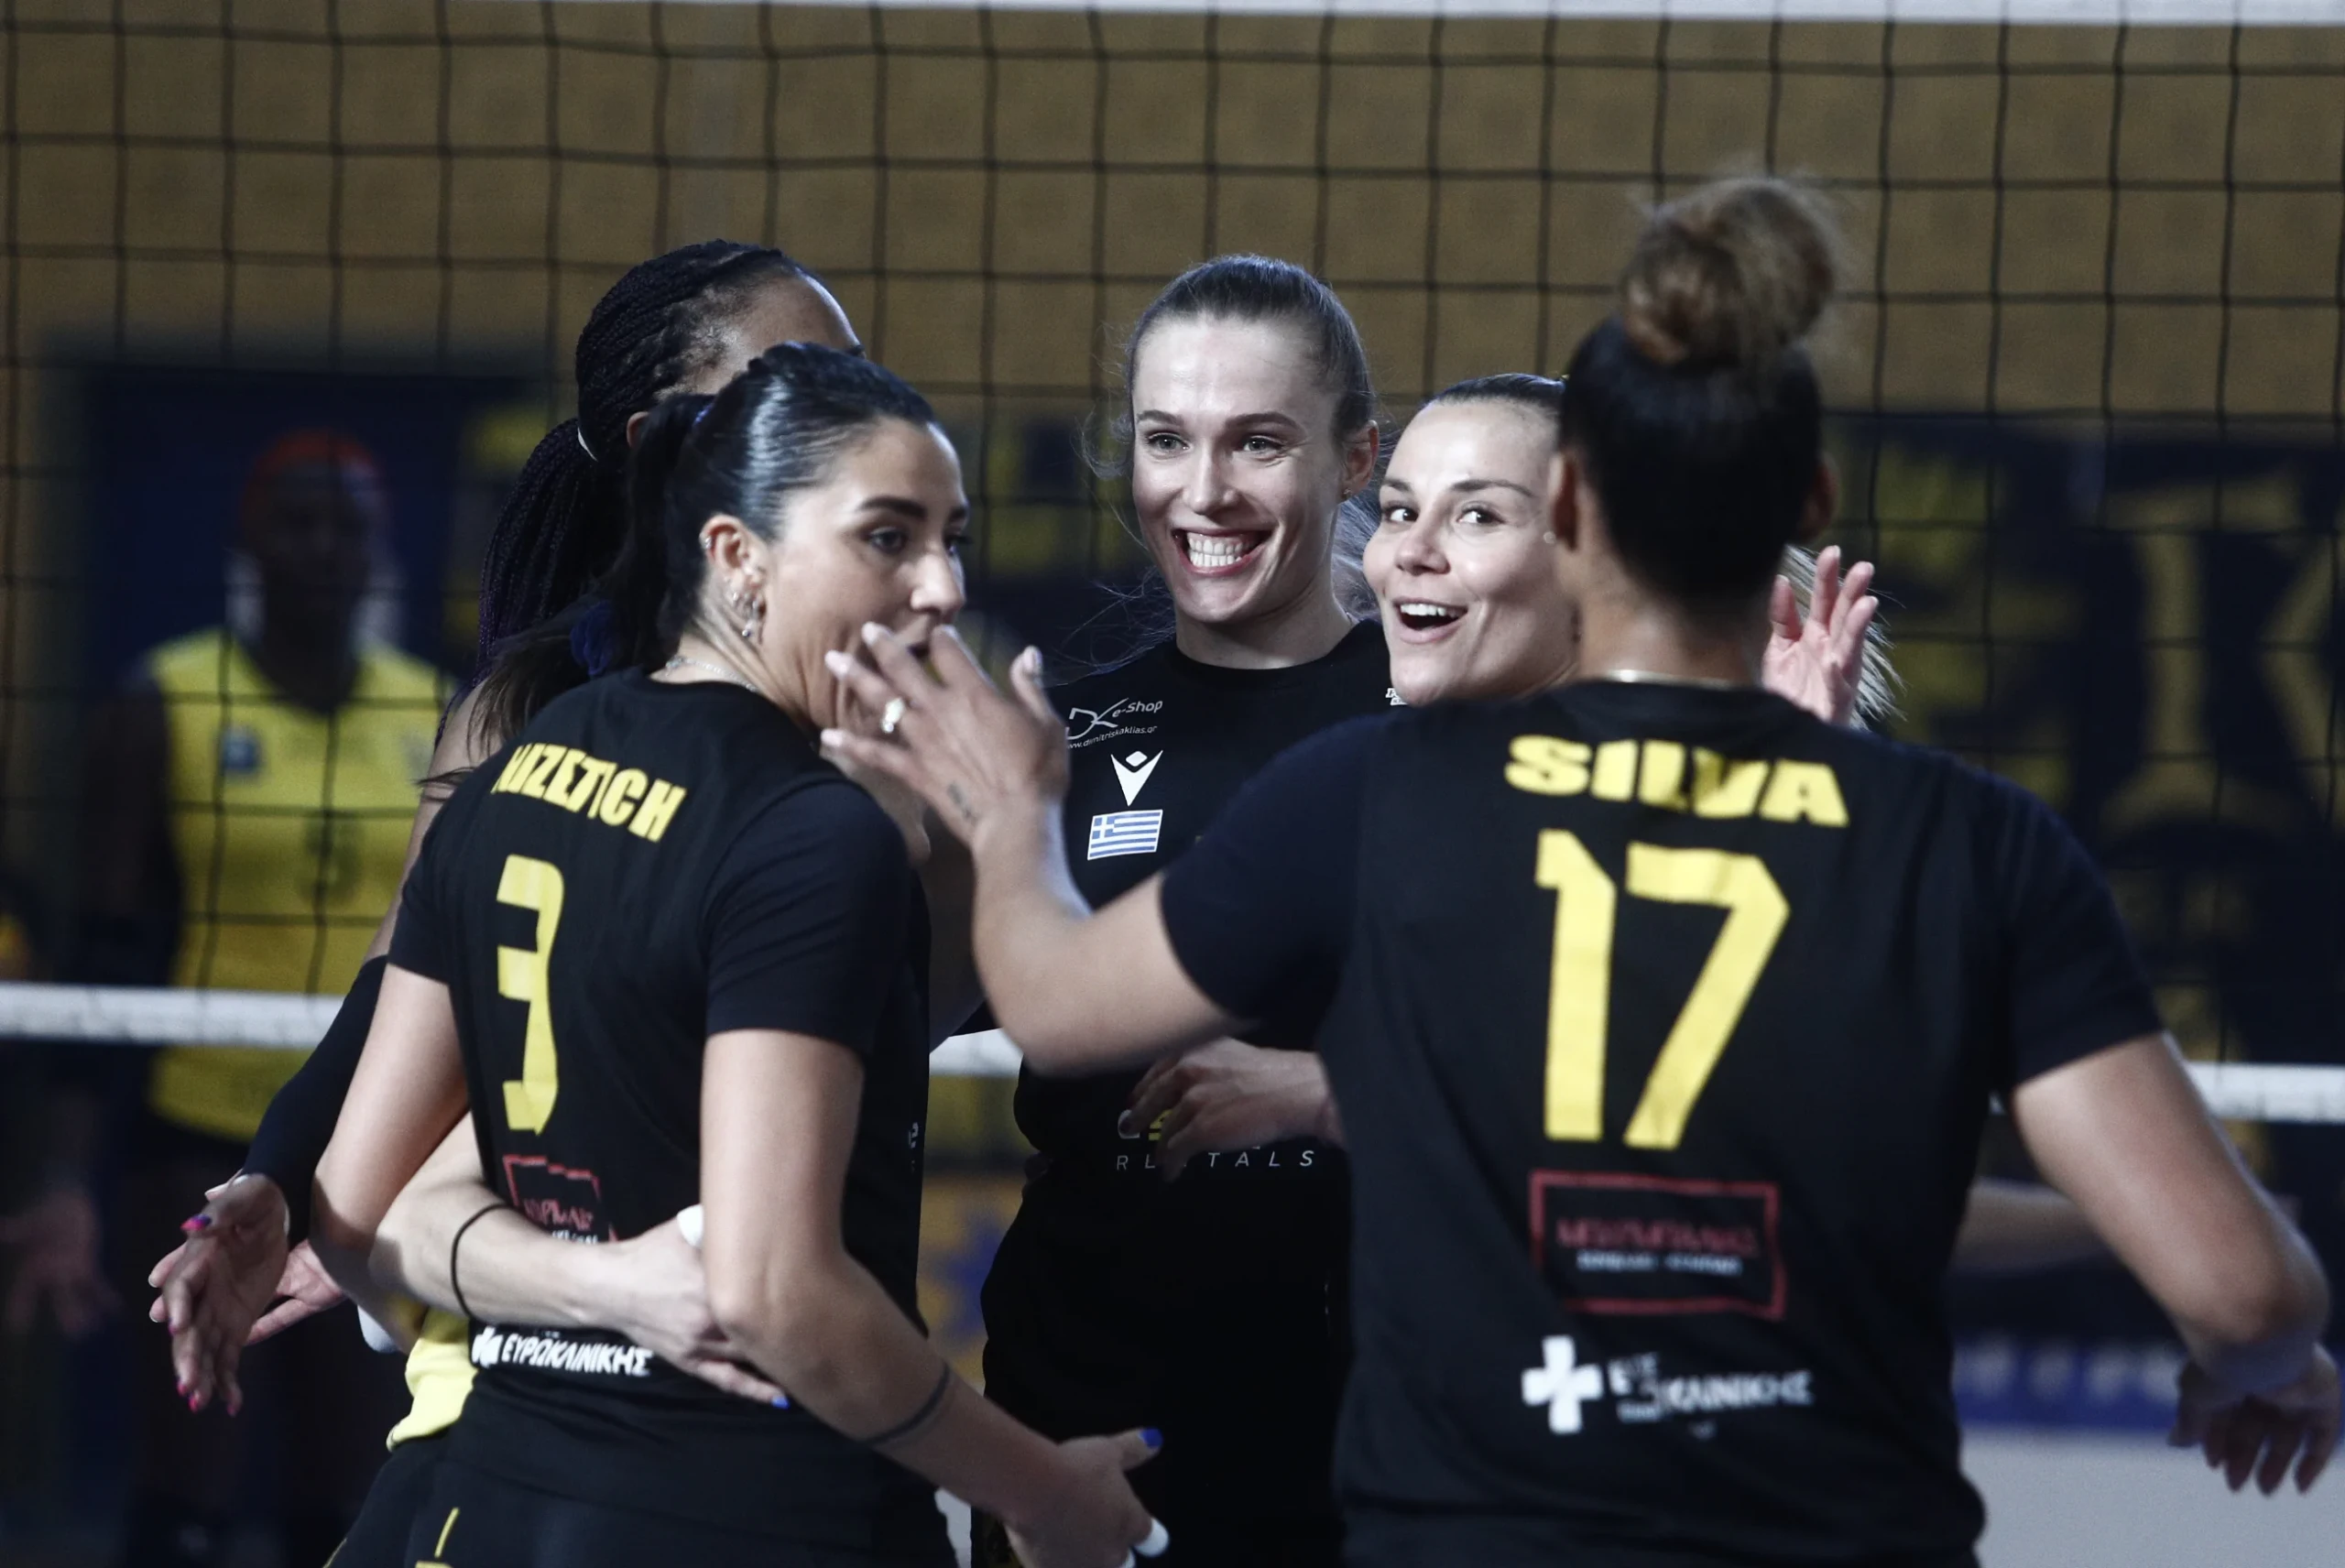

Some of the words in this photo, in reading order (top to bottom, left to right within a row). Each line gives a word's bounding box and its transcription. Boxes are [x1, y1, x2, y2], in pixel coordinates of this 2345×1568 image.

[1505, 735, 1849, 827] SILVA
[496, 854, 564, 1136] 3
[1535, 828, 1791, 1151] 17
[1116, 1149, 1315, 1171] RTALS
[502, 1333, 654, 1377] ΕΥΡΩΚΛΙΝΙΚΗΣ
